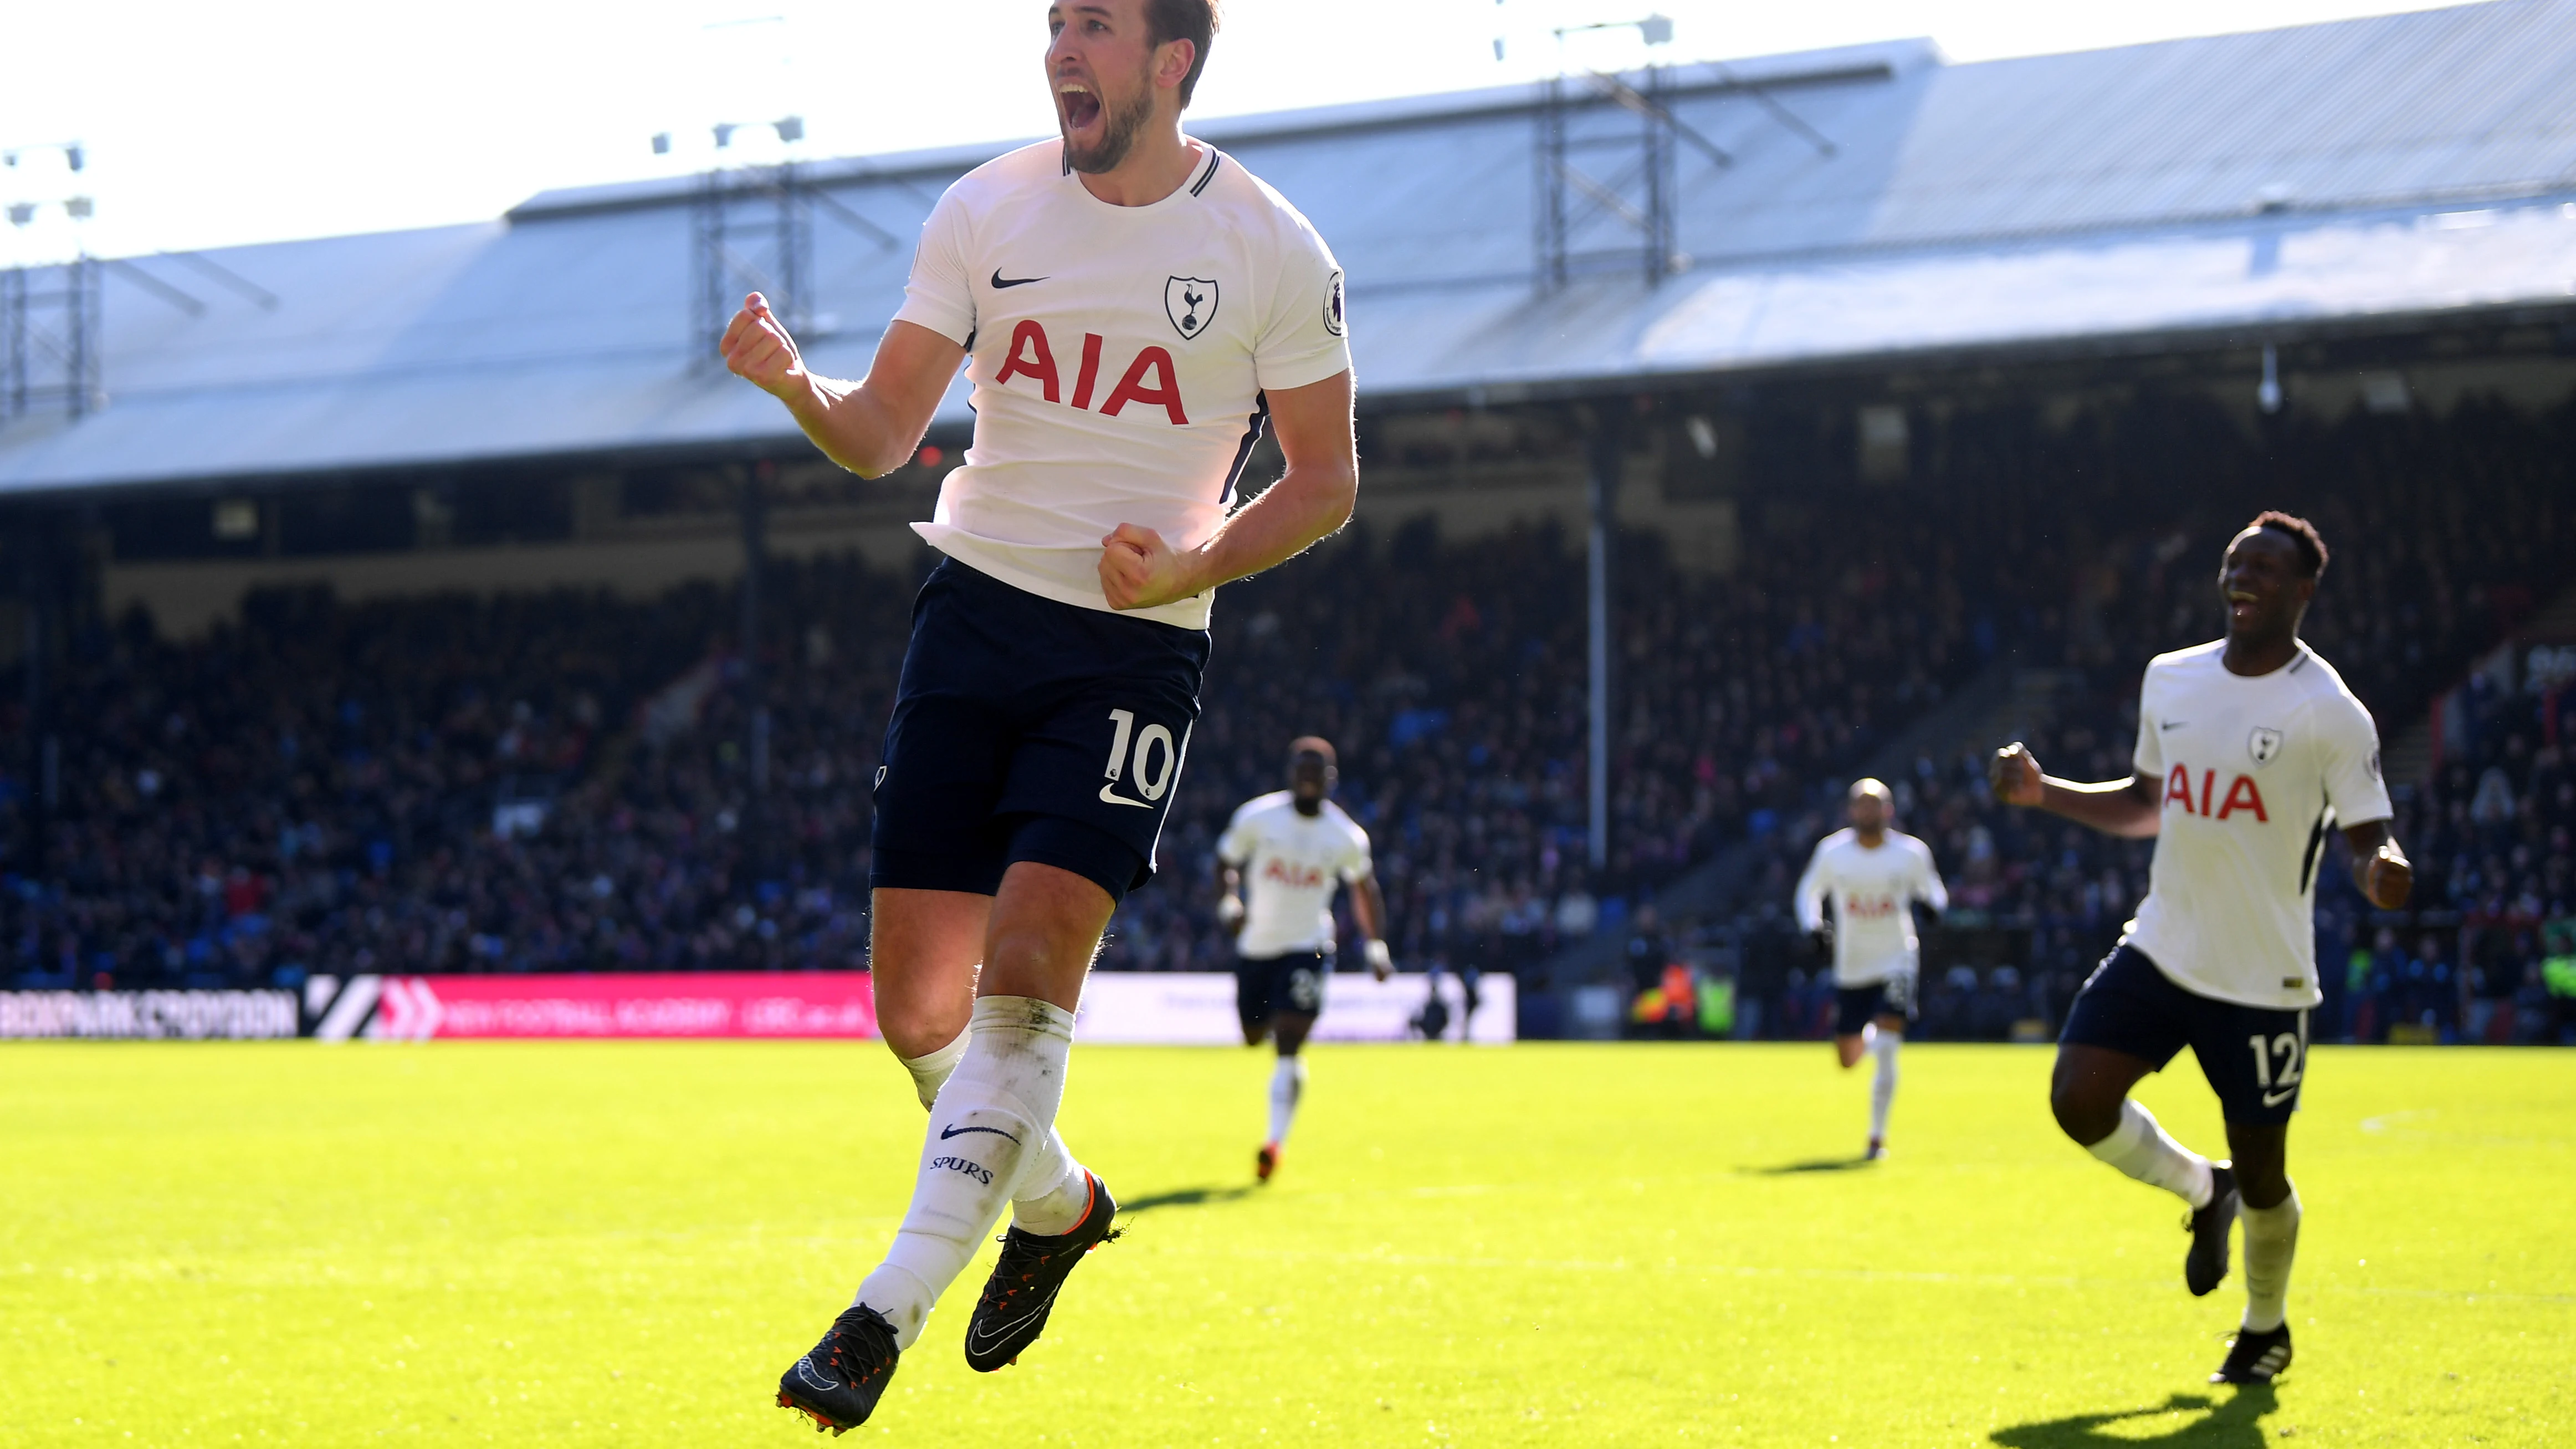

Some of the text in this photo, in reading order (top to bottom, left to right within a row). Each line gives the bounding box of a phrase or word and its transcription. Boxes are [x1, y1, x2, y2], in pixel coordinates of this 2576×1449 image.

[995, 320, 1189, 426] AIA
[1104, 709, 1174, 801] 10
[2165, 762, 2269, 823] AIA
[1264, 858, 1323, 887] AIA
[2249, 1032, 2301, 1088] 12
[930, 1156, 993, 1185] SPURS
